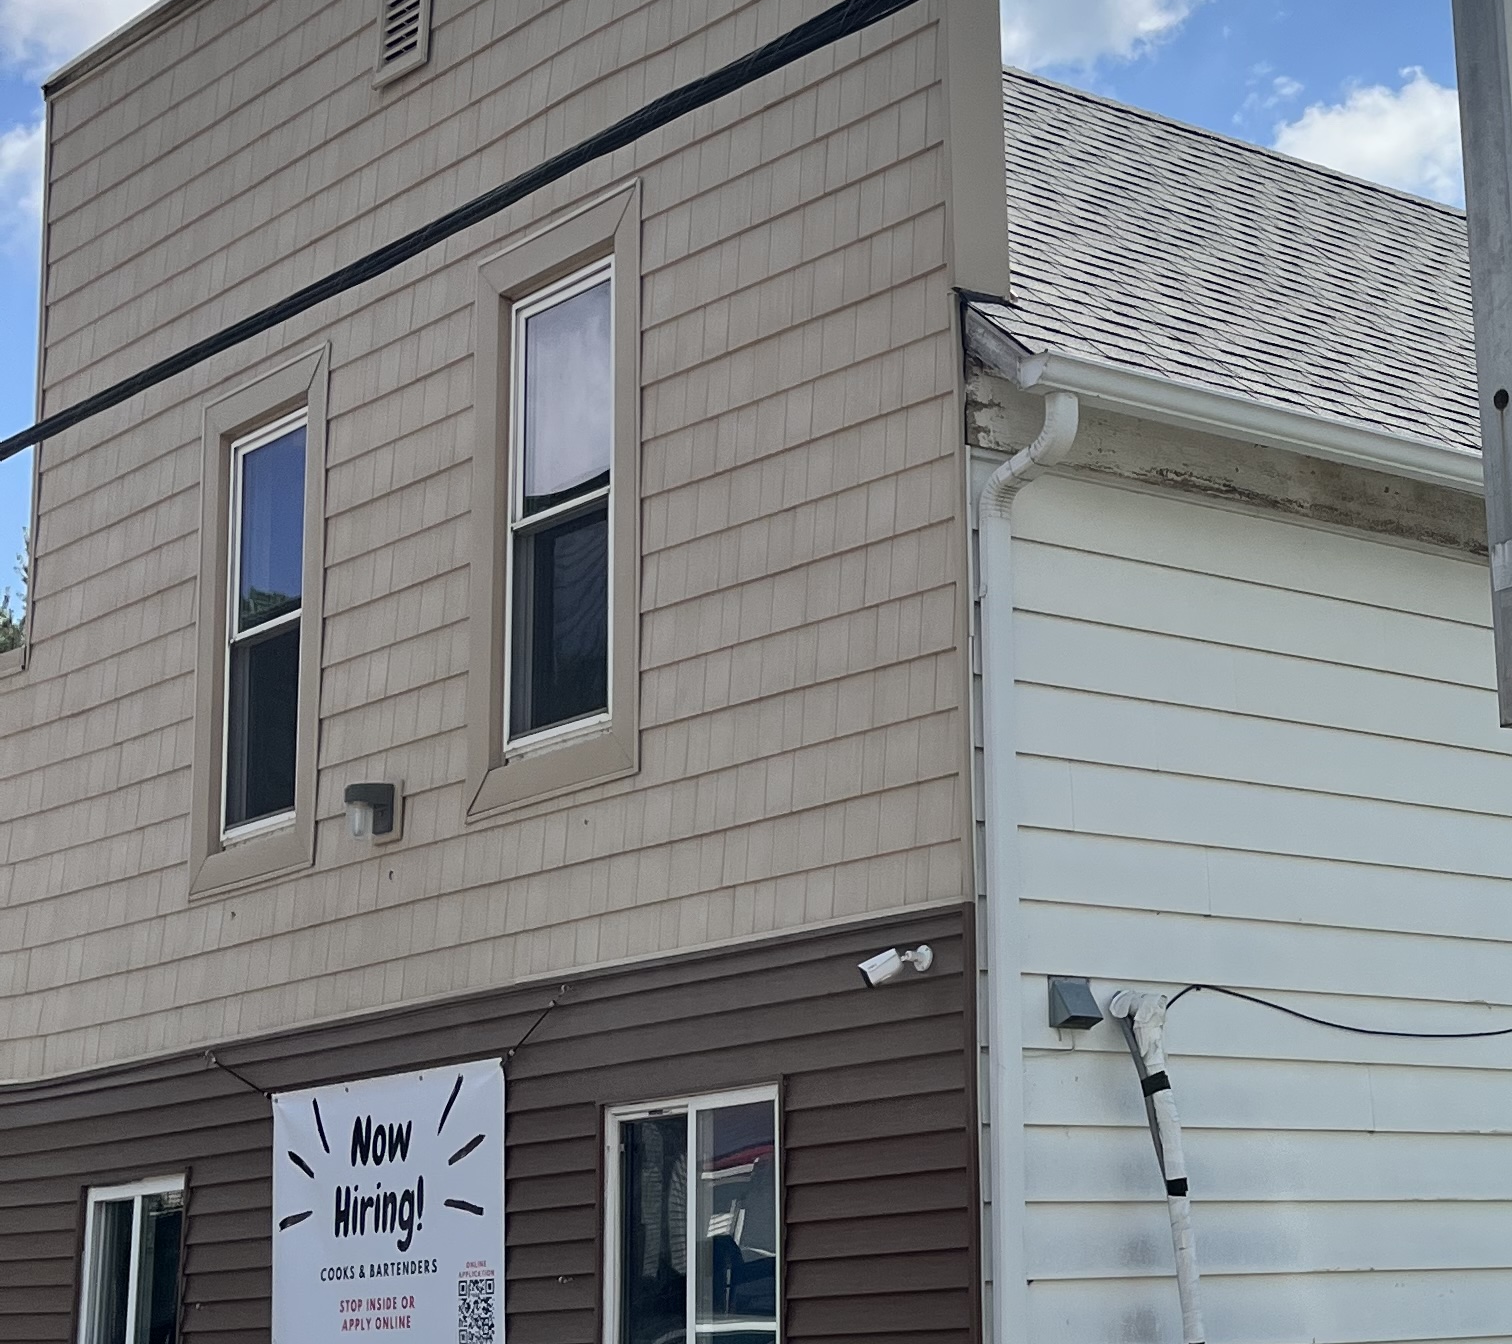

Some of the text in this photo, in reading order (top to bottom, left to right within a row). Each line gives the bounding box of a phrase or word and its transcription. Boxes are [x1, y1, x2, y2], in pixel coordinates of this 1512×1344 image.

[350, 1114, 413, 1168] Now
[333, 1174, 425, 1253] Hiring!
[320, 1258, 438, 1282] COOKS & BARTENDERS
[339, 1295, 416, 1314] STOP INSIDE OR
[341, 1314, 411, 1332] APPLY ONLINE
